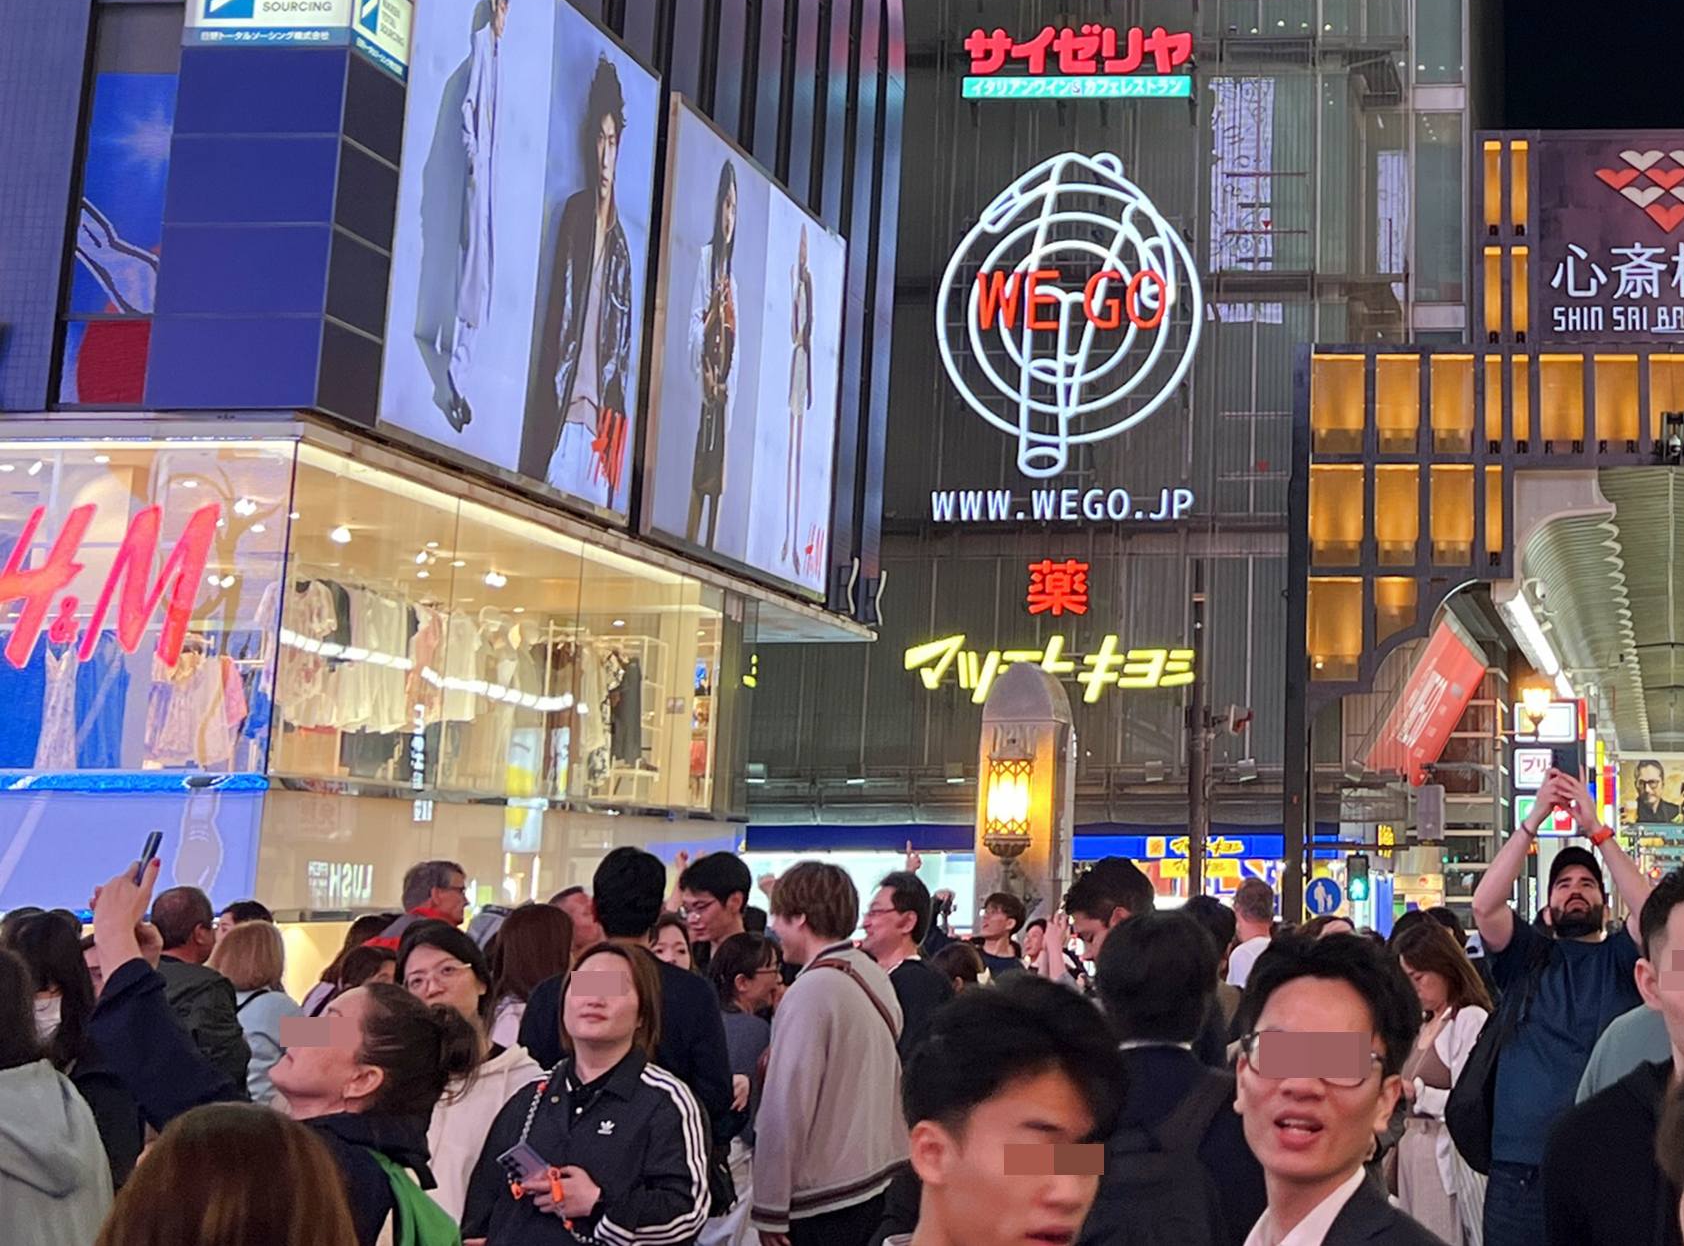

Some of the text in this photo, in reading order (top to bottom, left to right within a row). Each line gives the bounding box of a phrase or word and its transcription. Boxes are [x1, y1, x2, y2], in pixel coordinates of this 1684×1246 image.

[262, 1, 333, 12] SOURCING
[964, 23, 1192, 75] サイゼリヤ
[1553, 306, 1605, 331] SHIN
[931, 489, 1195, 522] WWW.WEGO.JP
[1026, 558, 1090, 617] 薬
